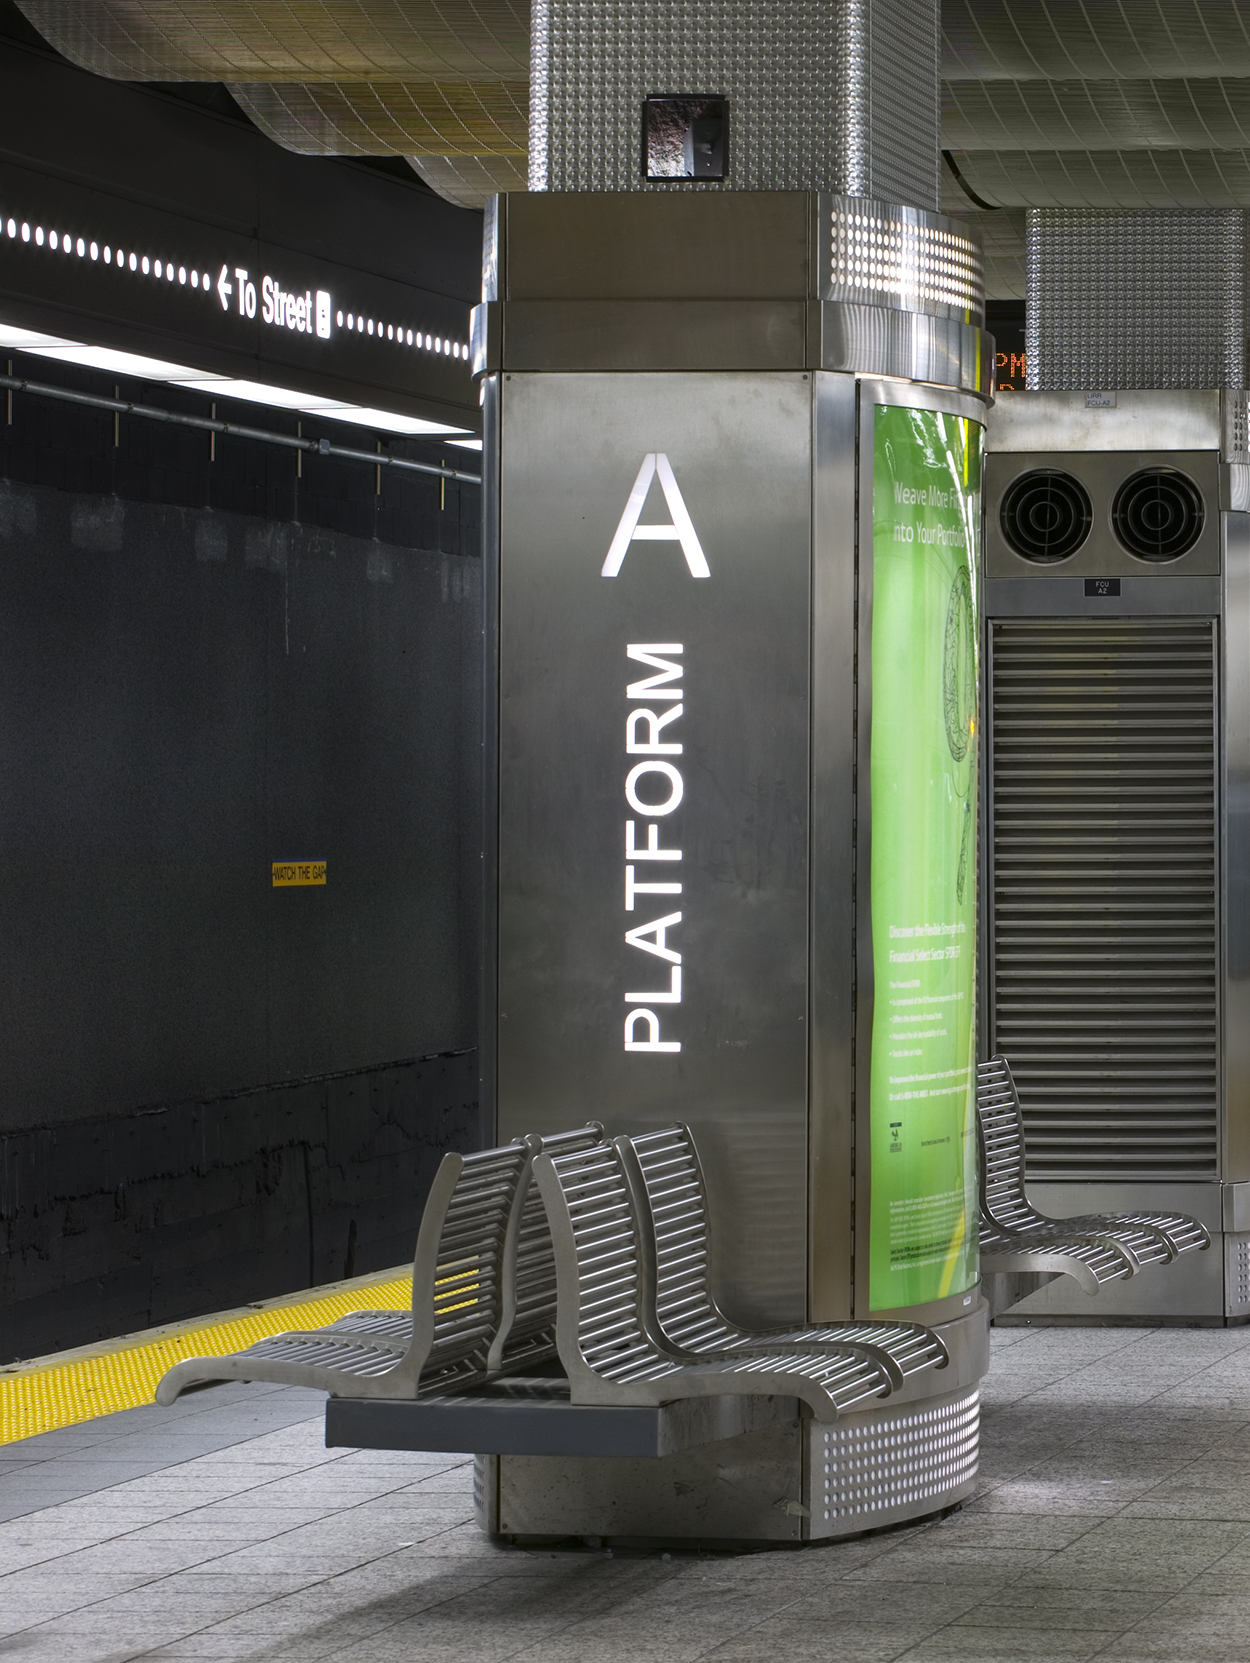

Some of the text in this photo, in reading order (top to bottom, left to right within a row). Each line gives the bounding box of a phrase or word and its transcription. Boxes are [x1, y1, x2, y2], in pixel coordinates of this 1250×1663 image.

[235, 267, 313, 334] To Street
[894, 482, 927, 505] Weave
[929, 485, 949, 508] More
[601, 453, 712, 578] A
[893, 520, 914, 542] into
[916, 522, 936, 543] Your
[1097, 587, 1107, 595] A2
[624, 643, 685, 1053] PLATFORM
[273, 866, 296, 880] WATCH
[298, 865, 310, 880] THE
[889, 925, 914, 938] Discover
[915, 924, 924, 937] the
[889, 949, 914, 962] Financial
[916, 948, 930, 961] Select
[931, 947, 945, 960] Sector
